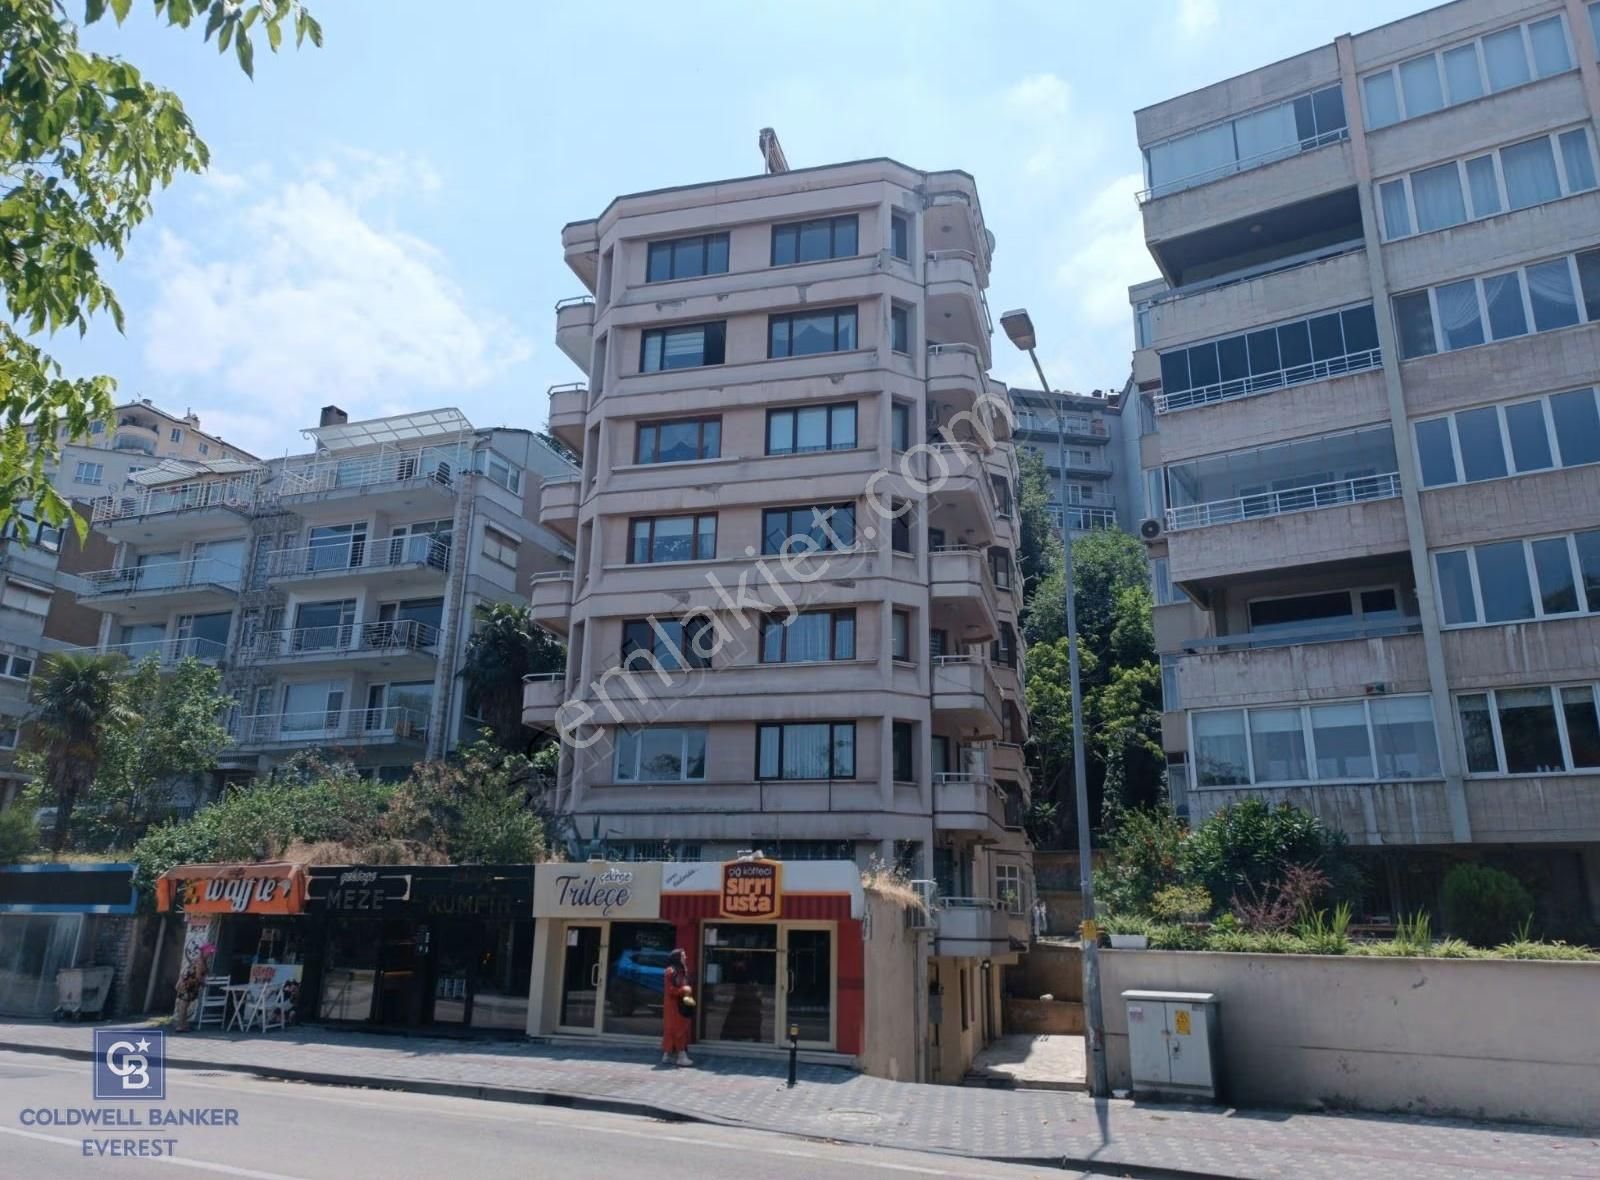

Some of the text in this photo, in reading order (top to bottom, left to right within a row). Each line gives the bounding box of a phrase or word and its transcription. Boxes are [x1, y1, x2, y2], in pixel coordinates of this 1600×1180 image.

[326, 889, 385, 910] MEZE
[555, 876, 632, 917] Trileçe
[726, 893, 771, 912] usta
